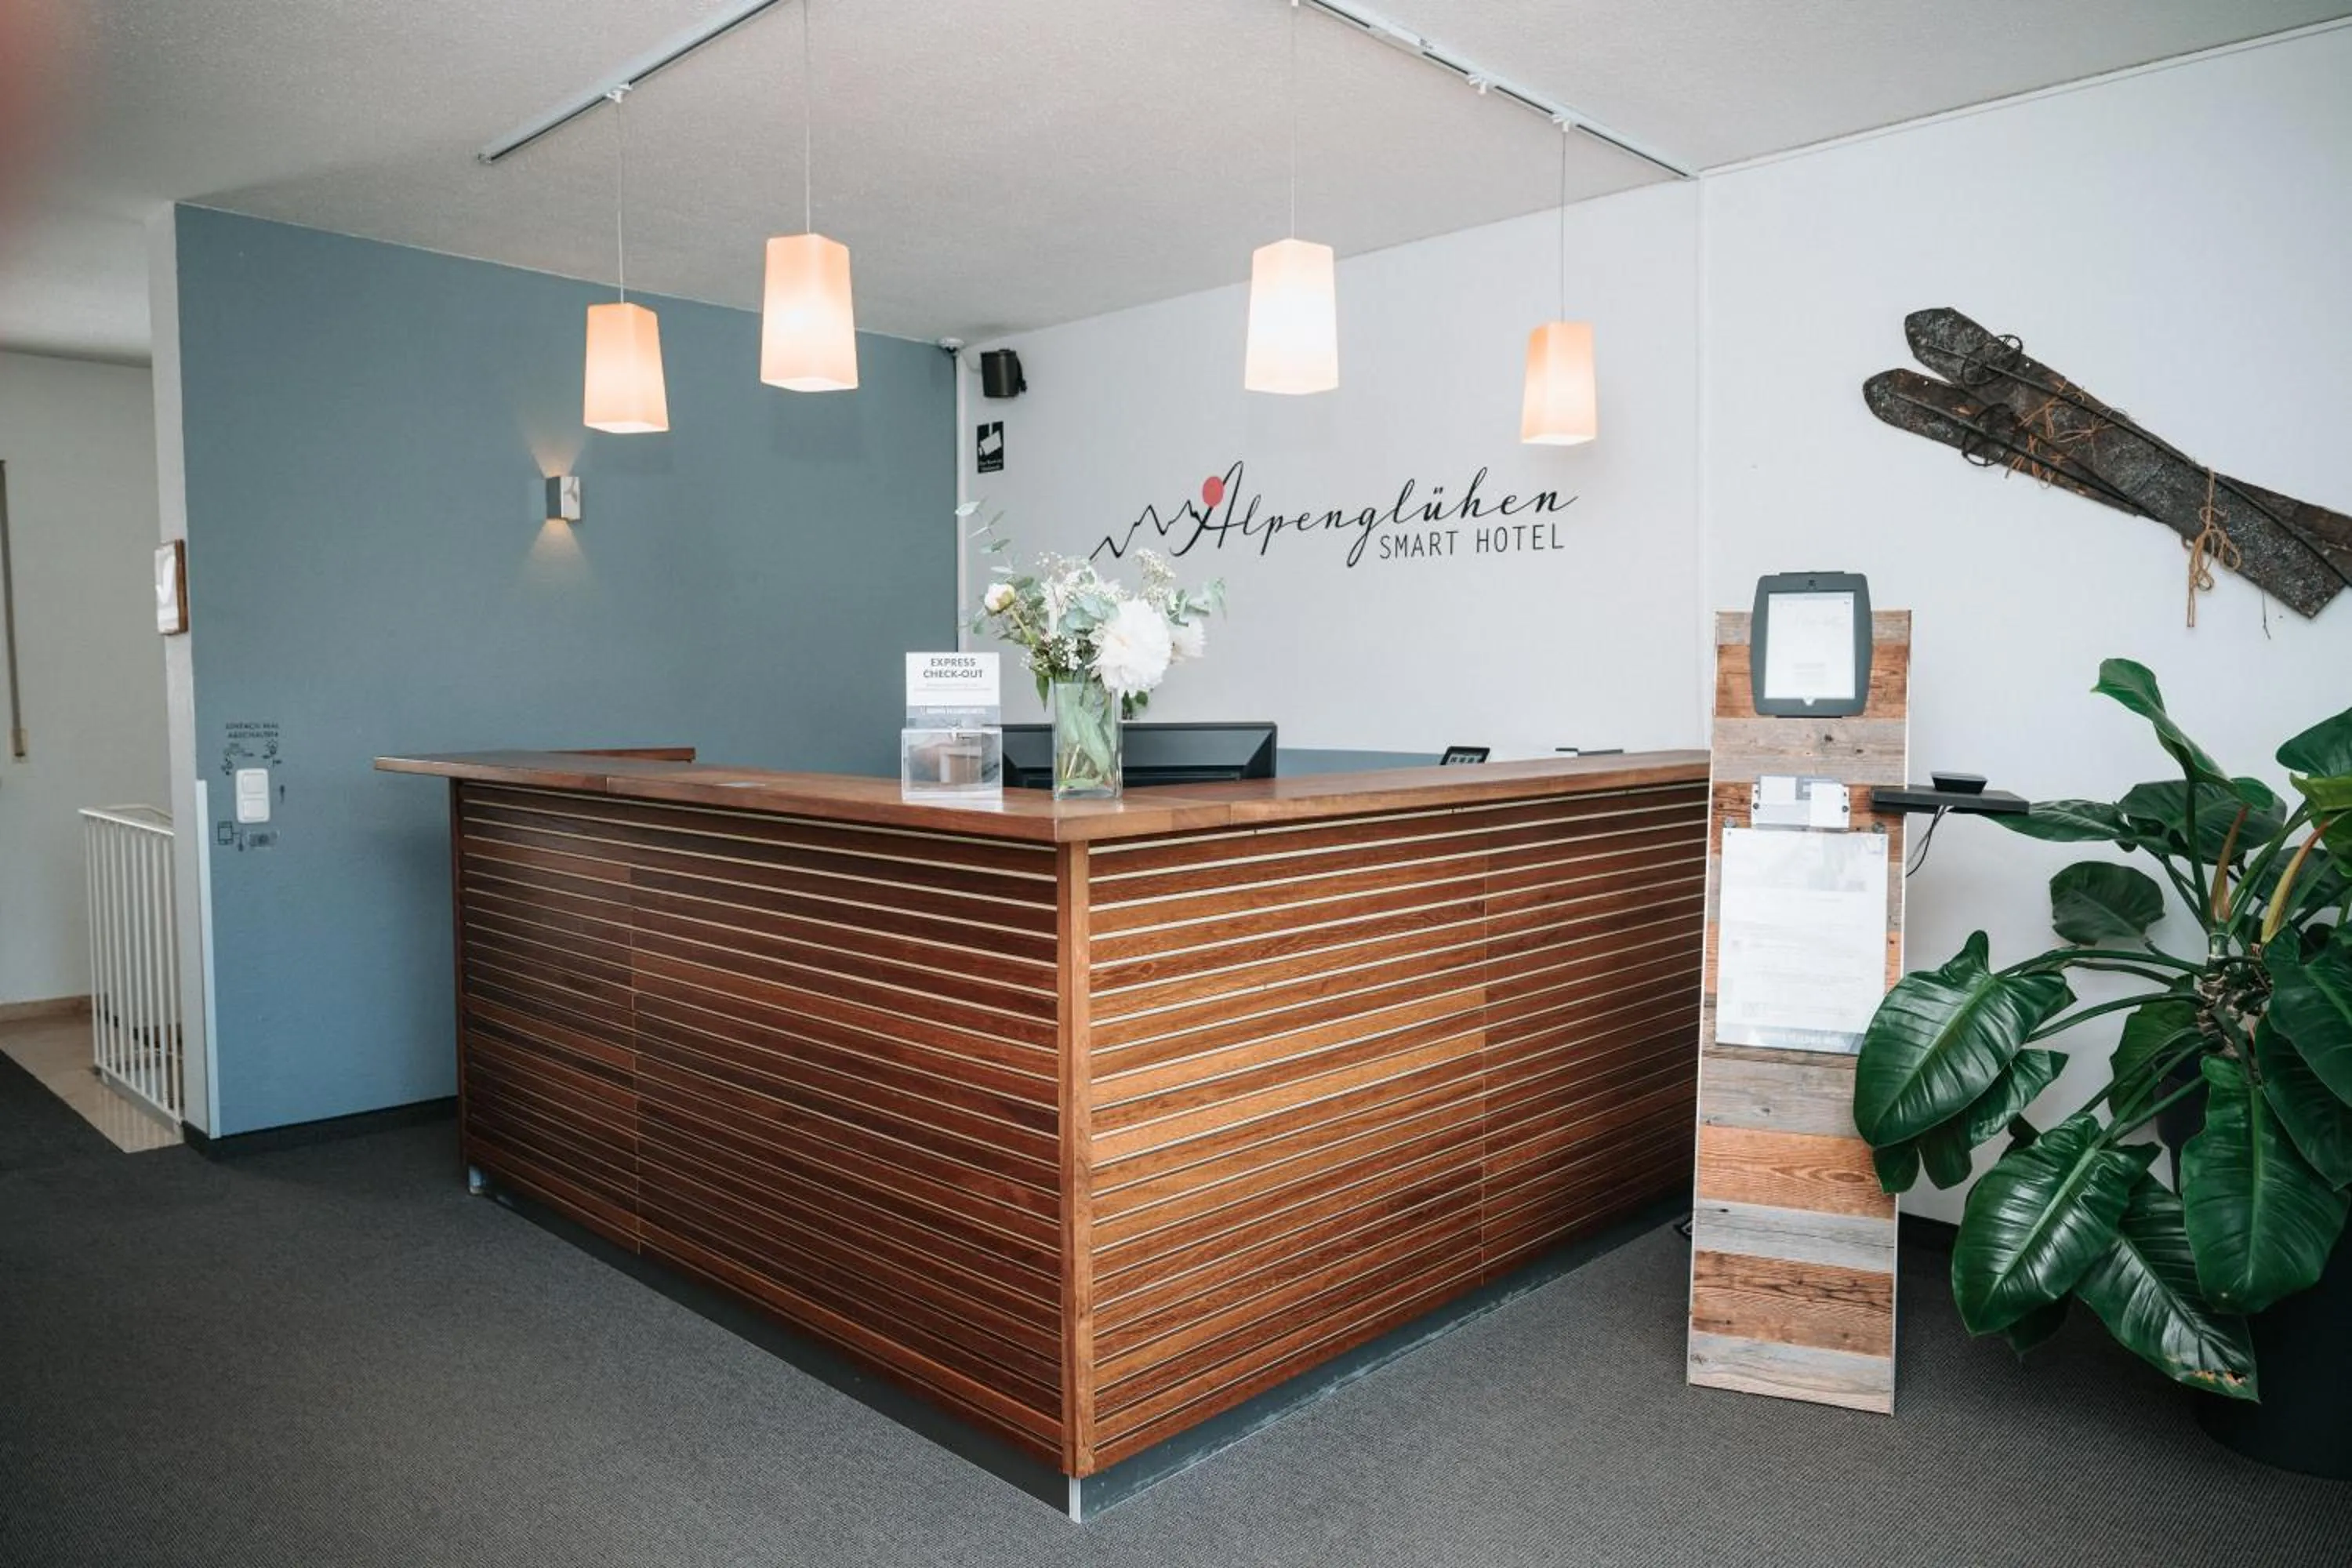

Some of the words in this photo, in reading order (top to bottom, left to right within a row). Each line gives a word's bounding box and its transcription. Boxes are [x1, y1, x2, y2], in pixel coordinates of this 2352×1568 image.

[1169, 459, 1579, 568] Alpenglühen
[1379, 530, 1460, 560] SMART
[1476, 522, 1565, 554] HOTEL
[923, 669, 983, 678] CHECK-OUT
[930, 658, 977, 666] EXPRESS
